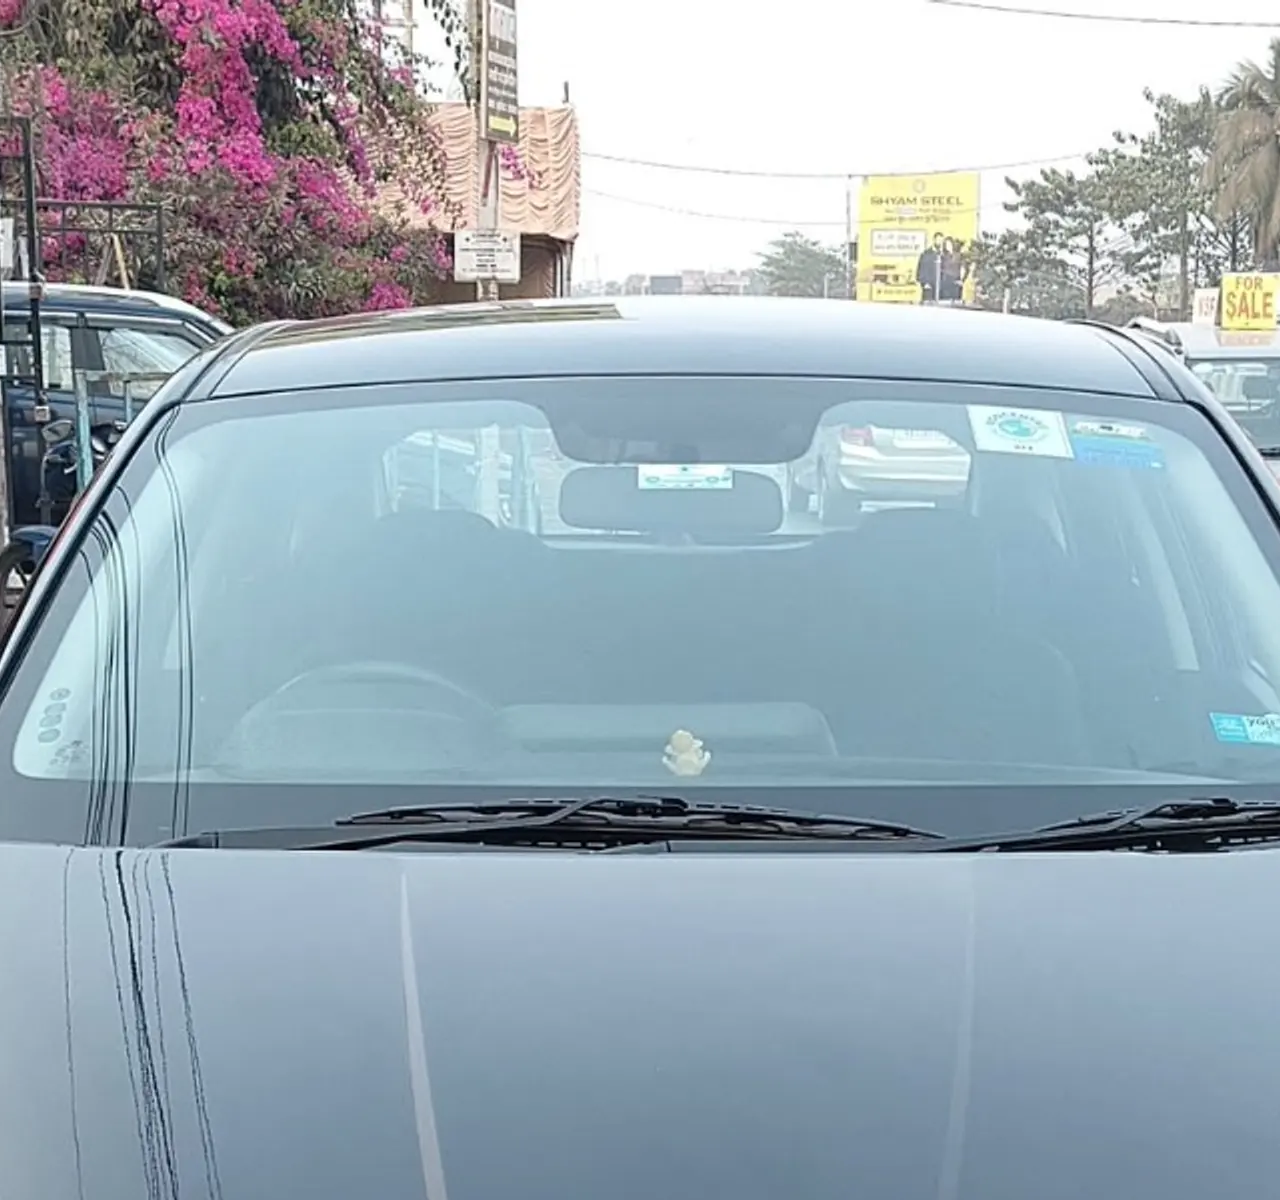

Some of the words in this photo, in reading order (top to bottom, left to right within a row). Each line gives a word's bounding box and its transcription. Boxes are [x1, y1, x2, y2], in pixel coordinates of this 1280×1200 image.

[870, 196, 917, 206] SHYAM
[921, 196, 964, 206] STEEL
[1235, 276, 1264, 290] FOR
[1226, 291, 1273, 319] SALE
